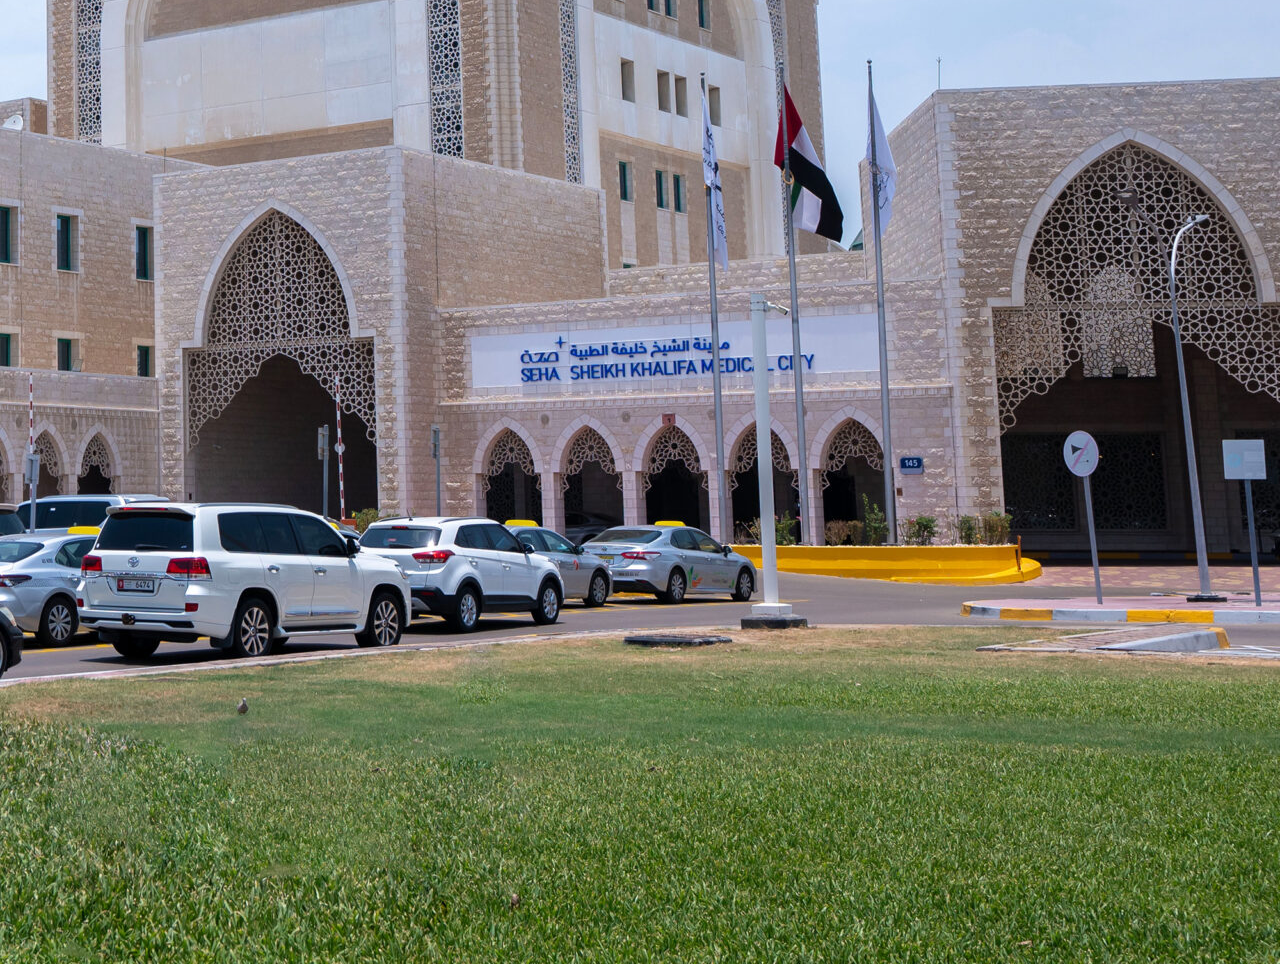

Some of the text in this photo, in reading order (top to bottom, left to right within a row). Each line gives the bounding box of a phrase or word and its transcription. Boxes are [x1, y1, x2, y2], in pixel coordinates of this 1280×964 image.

[570, 337, 730, 360] مينة الشيخ خليفة الطبية
[520, 349, 559, 364] صحة
[521, 367, 561, 382] SEHA
[570, 363, 626, 380] SHEIKH
[630, 359, 698, 377] KHALIFA
[701, 356, 775, 374] MEDIC
[904, 459, 918, 467] 145
